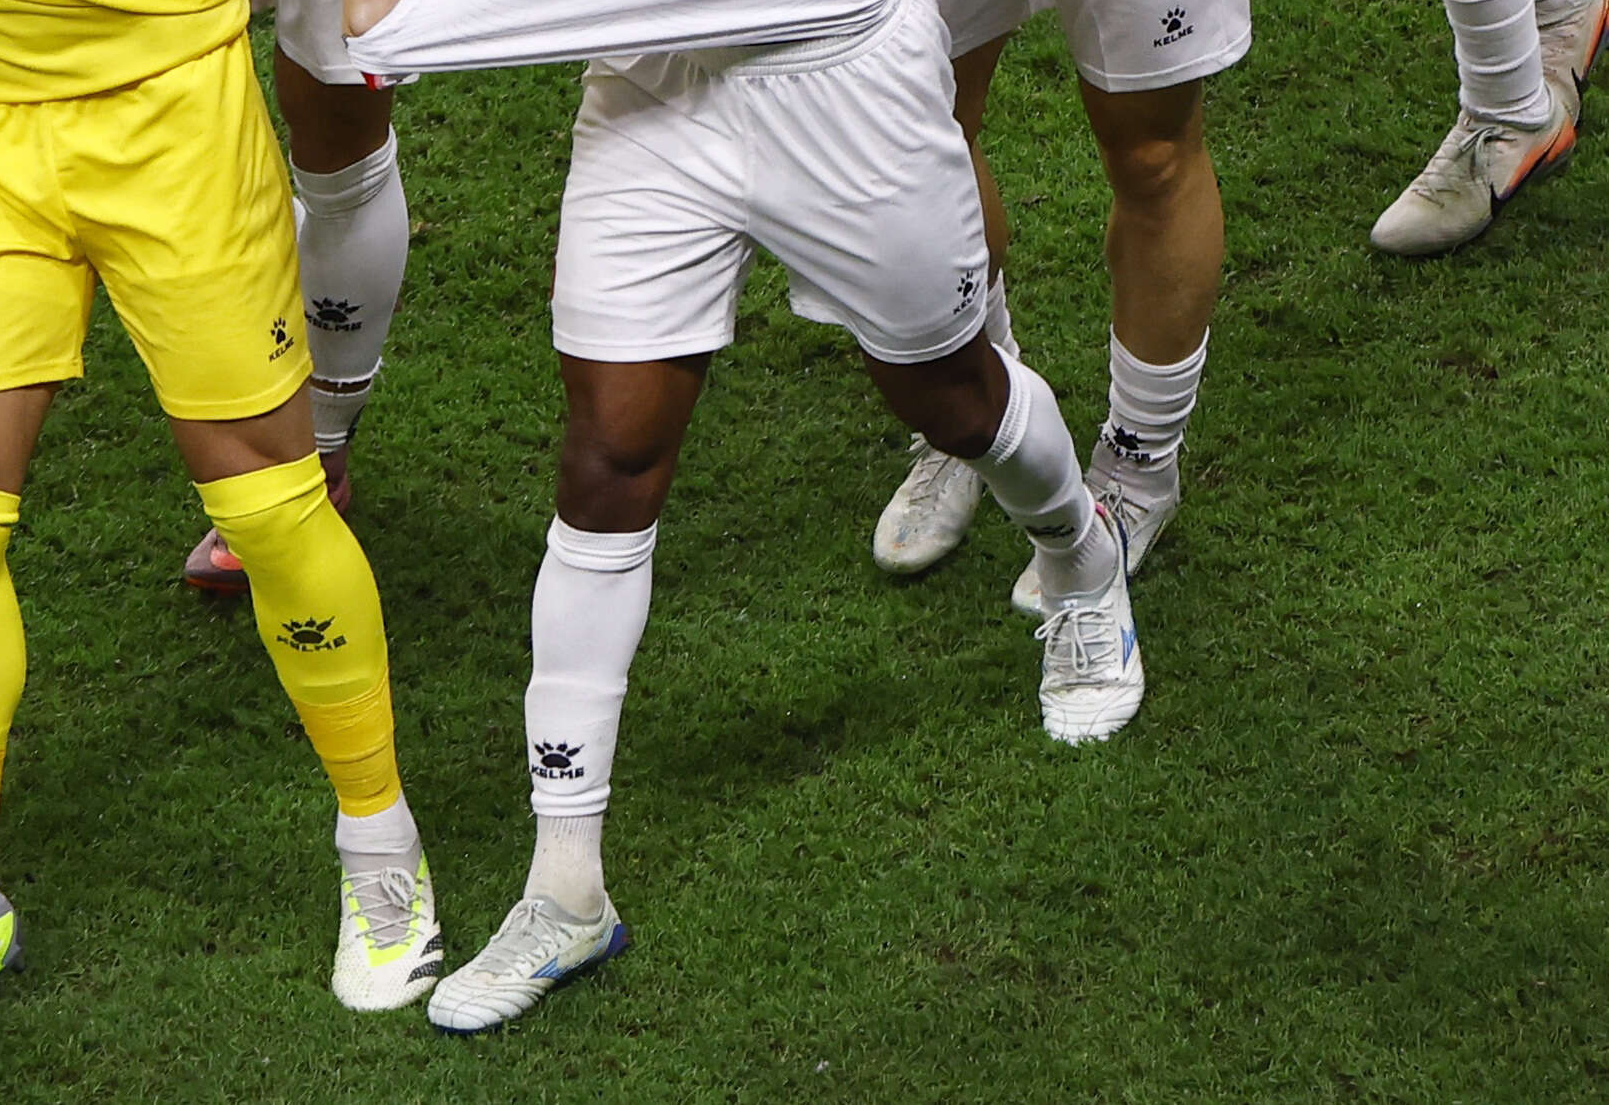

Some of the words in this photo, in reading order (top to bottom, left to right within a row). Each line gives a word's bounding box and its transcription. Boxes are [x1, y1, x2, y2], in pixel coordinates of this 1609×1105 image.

[1153, 25, 1194, 48] KELME
[269, 336, 295, 362] KELME
[531, 763, 585, 779] KELME
